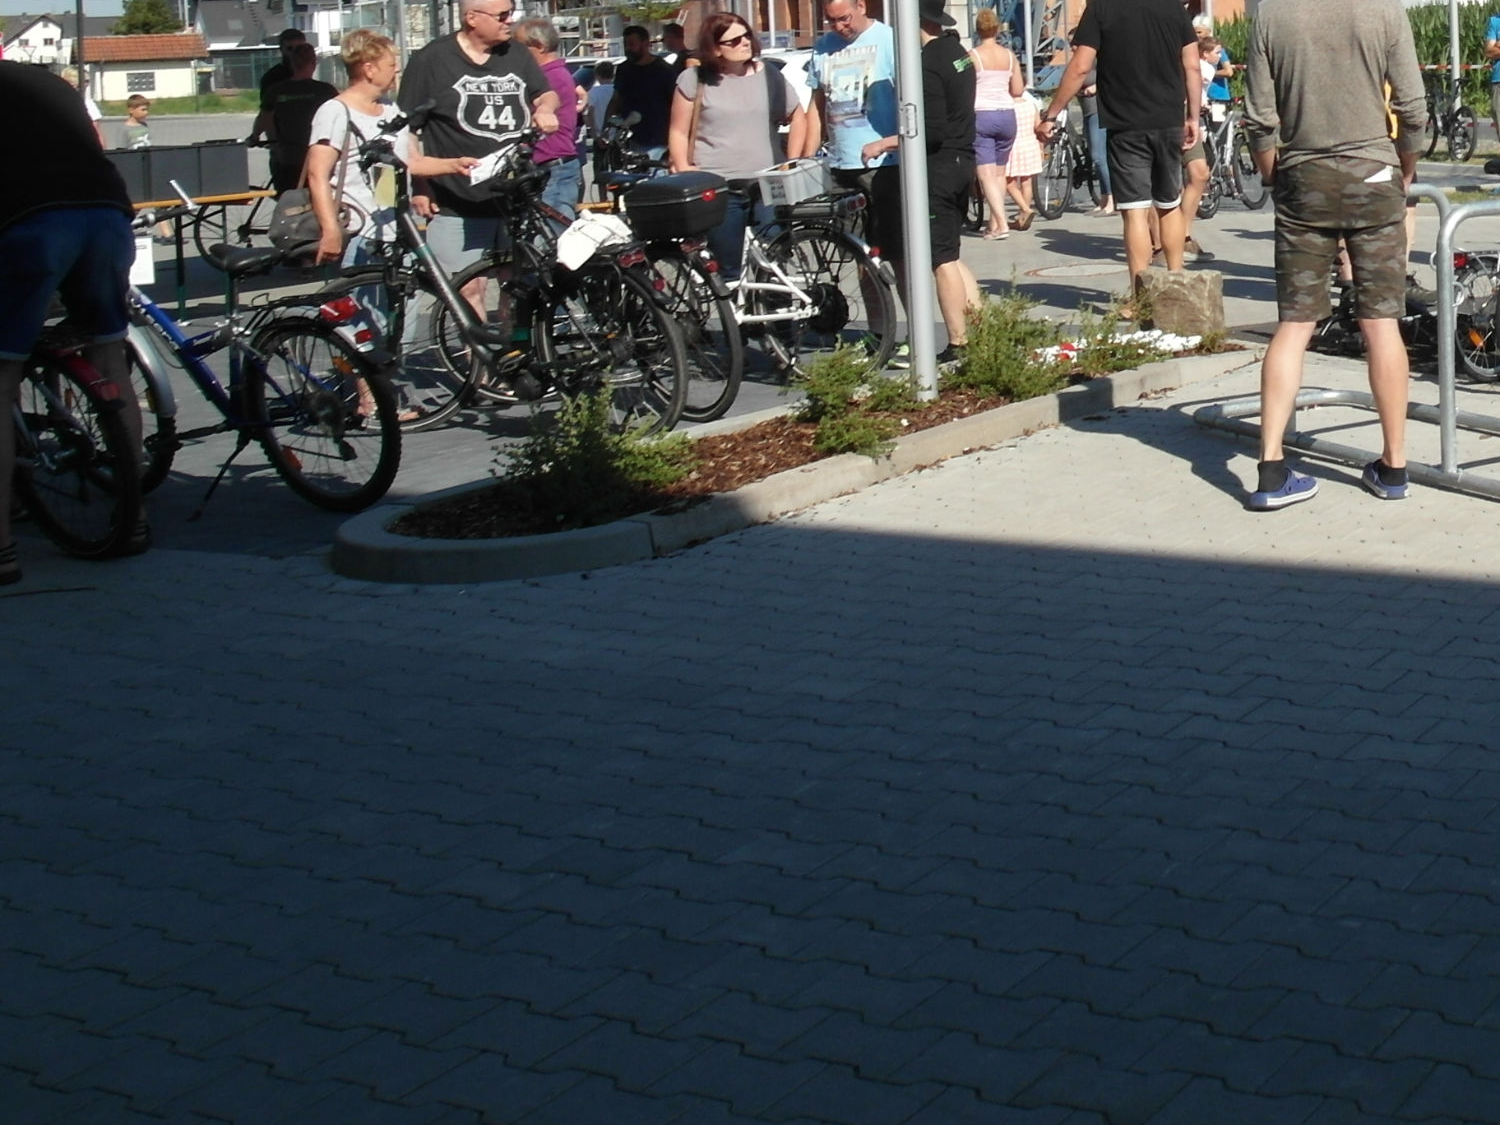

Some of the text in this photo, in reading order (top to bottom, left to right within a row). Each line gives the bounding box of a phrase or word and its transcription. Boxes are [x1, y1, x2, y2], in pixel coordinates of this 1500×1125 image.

[465, 81, 518, 92] NEW YORK
[484, 95, 504, 106] US
[477, 105, 516, 131] 44
